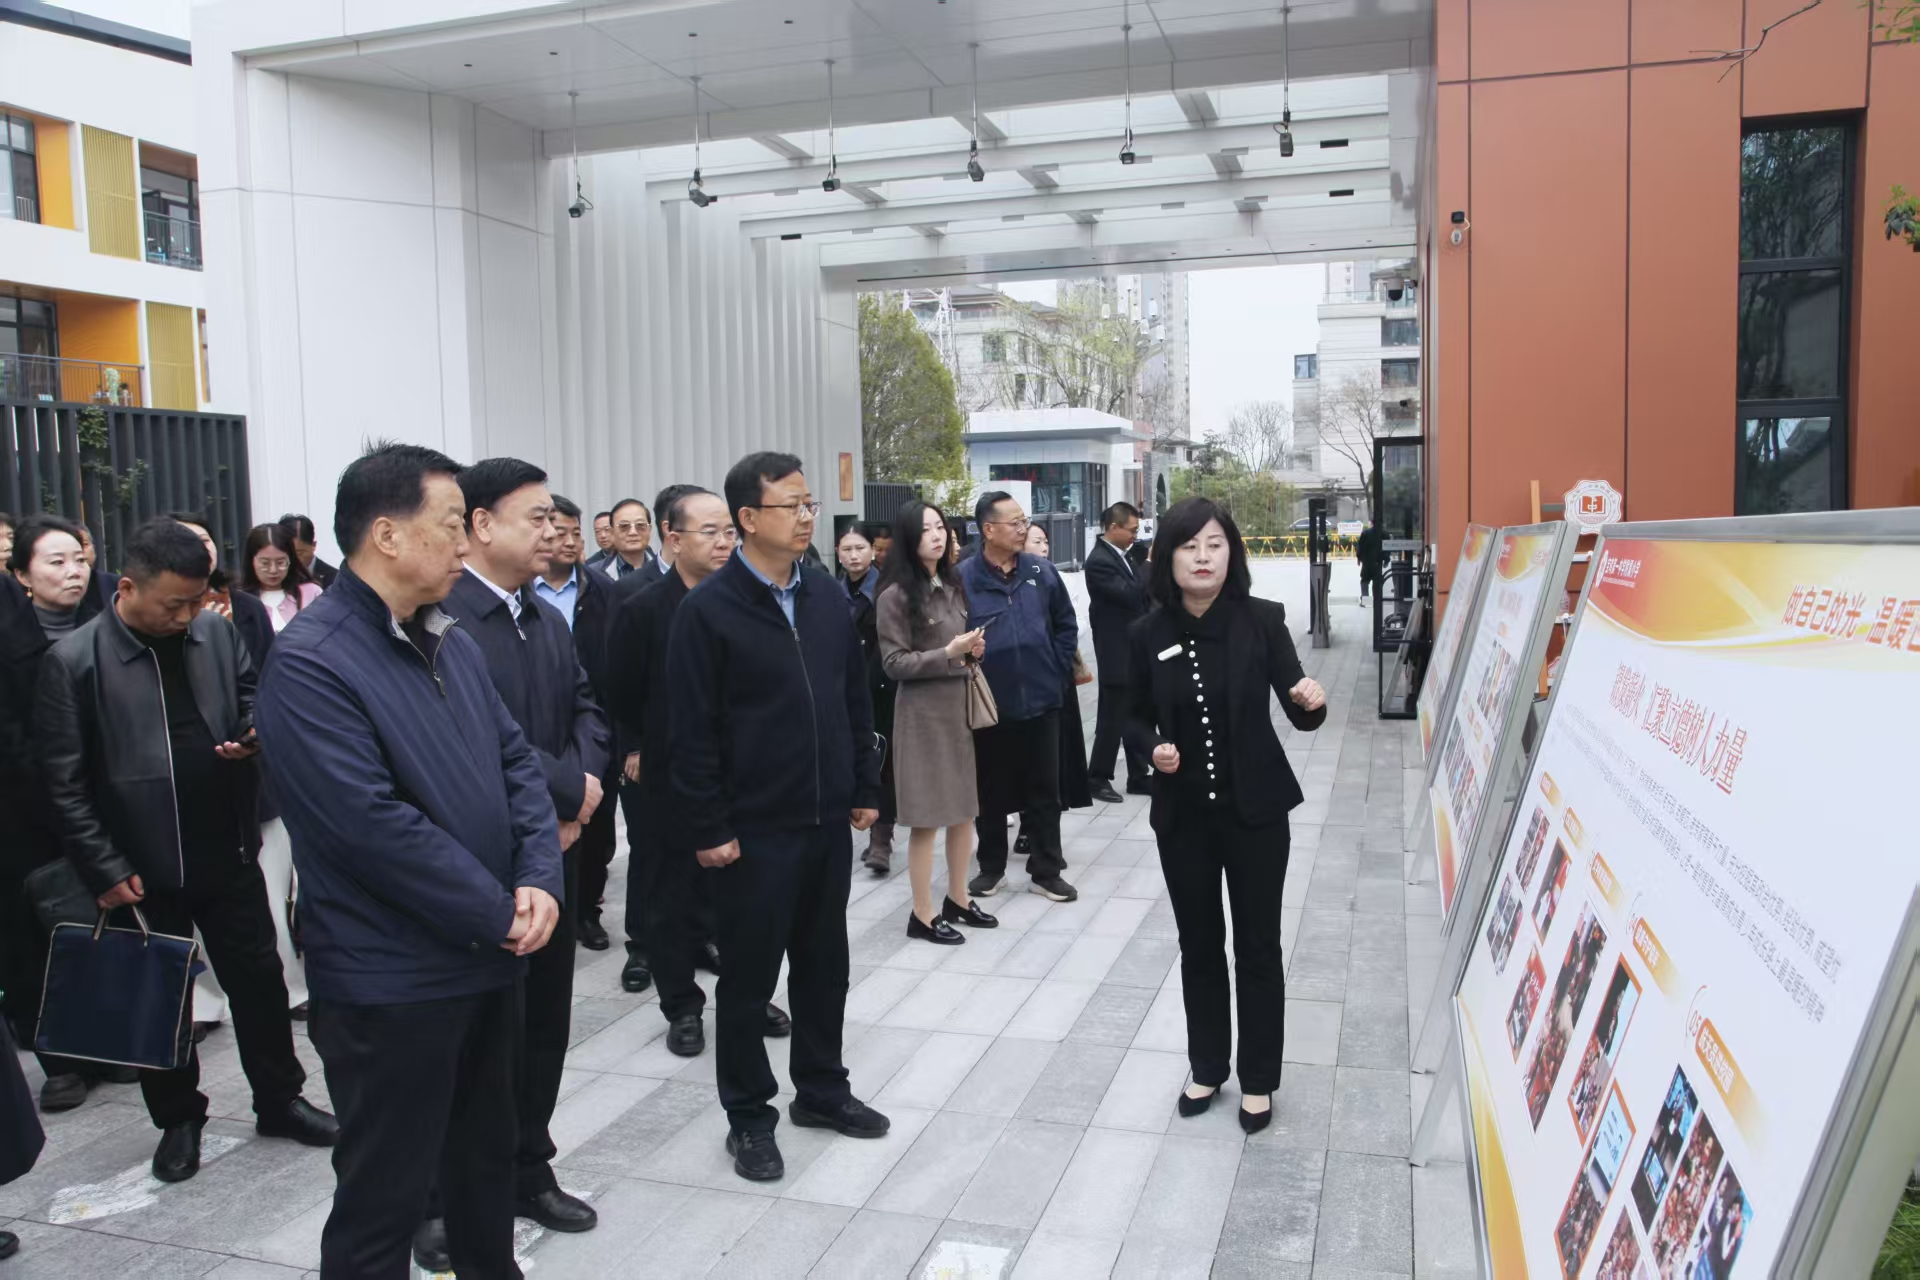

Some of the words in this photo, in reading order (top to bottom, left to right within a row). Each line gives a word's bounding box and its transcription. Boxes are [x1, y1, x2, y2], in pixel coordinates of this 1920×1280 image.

[1781, 584, 1866, 638] 做自己的光
[1641, 680, 1747, 795] 汇聚立德树人力量
